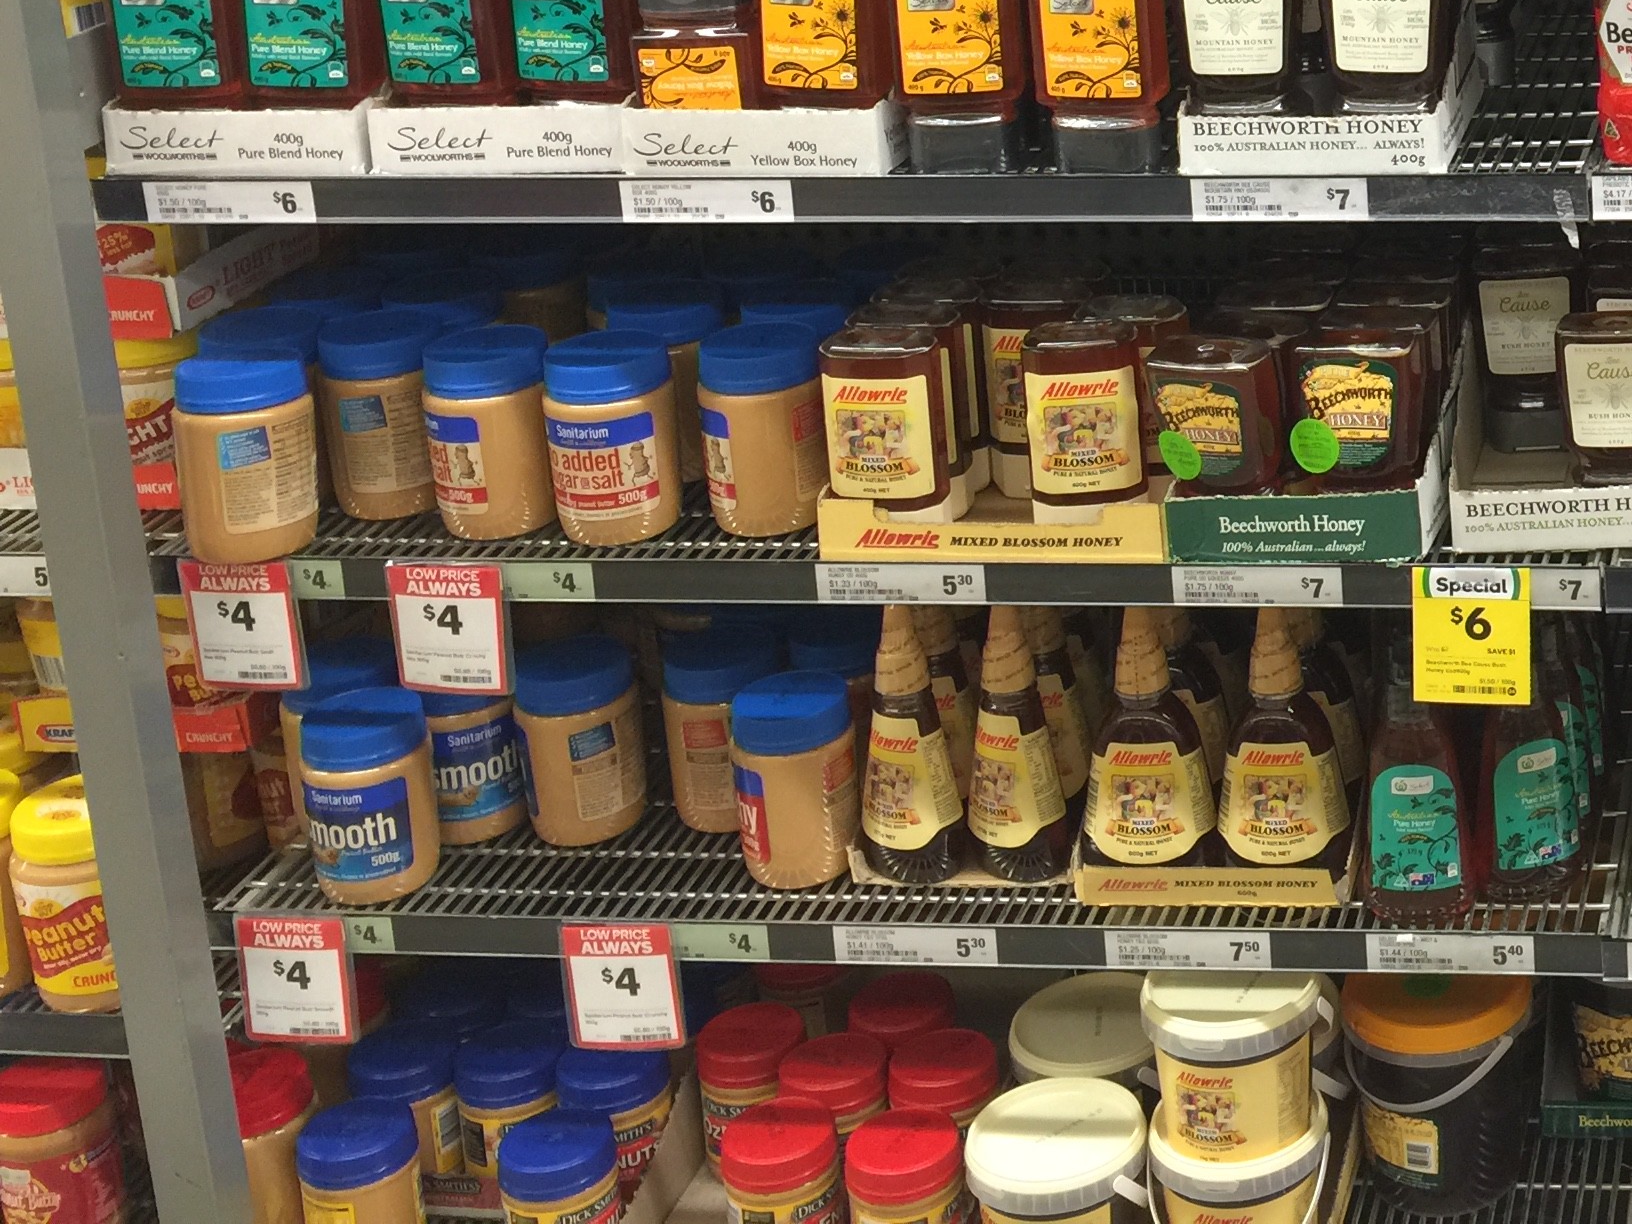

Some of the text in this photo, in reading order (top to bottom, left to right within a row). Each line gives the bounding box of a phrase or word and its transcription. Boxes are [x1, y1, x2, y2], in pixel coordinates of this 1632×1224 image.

[1192, 119, 1424, 137] BEECHWORTH HONEY
[120, 125, 224, 152] Select
[273, 132, 303, 147] 400g
[633, 132, 739, 157] Select
[1194, 142, 1225, 153] 100%
[1227, 140, 1306, 151] AUSTRALIAN
[1374, 137, 1426, 150] ALWAYS!
[144, 152, 205, 162] WOOLWORTHS
[238, 146, 344, 162] Pure Blend Honey
[787, 141, 817, 155] 400g
[750, 154, 858, 170] Yellow Box Honey
[1390, 152, 1426, 167] 400g
[752, 191, 775, 214] $6
[1326, 187, 1350, 211] $7
[833, 384, 908, 405] Allowrie
[1041, 379, 1120, 402] Allowrie
[556, 424, 609, 439] Sanitarium
[618, 489, 648, 507] 500g
[1466, 498, 1612, 519] BEECHWORTH
[1219, 514, 1366, 536] Beechworth Honey
[1465, 522, 1494, 533] 100%
[1496, 518, 1575, 531] AUSTRALIAN
[856, 528, 1123, 551] Allowrie MIXED BLOSSOM HONEY
[1222, 542, 1253, 553] 100%
[199, 564, 269, 576] LOW PRICE
[200, 577, 271, 592] ALWAYS
[1436, 576, 1508, 596] Special
[1559, 579, 1582, 601] $7
[217, 600, 256, 632] $4
[423, 604, 463, 635] $4
[1450, 606, 1492, 640] $6
[186, 731, 232, 744] CRUNCHY
[1243, 750, 1305, 767] Allowrie
[1099, 877, 1319, 892] Allowrie MIXED BLOSSOM HONEY
[37, 931, 96, 962] Butter
[601, 966, 640, 996] $4
